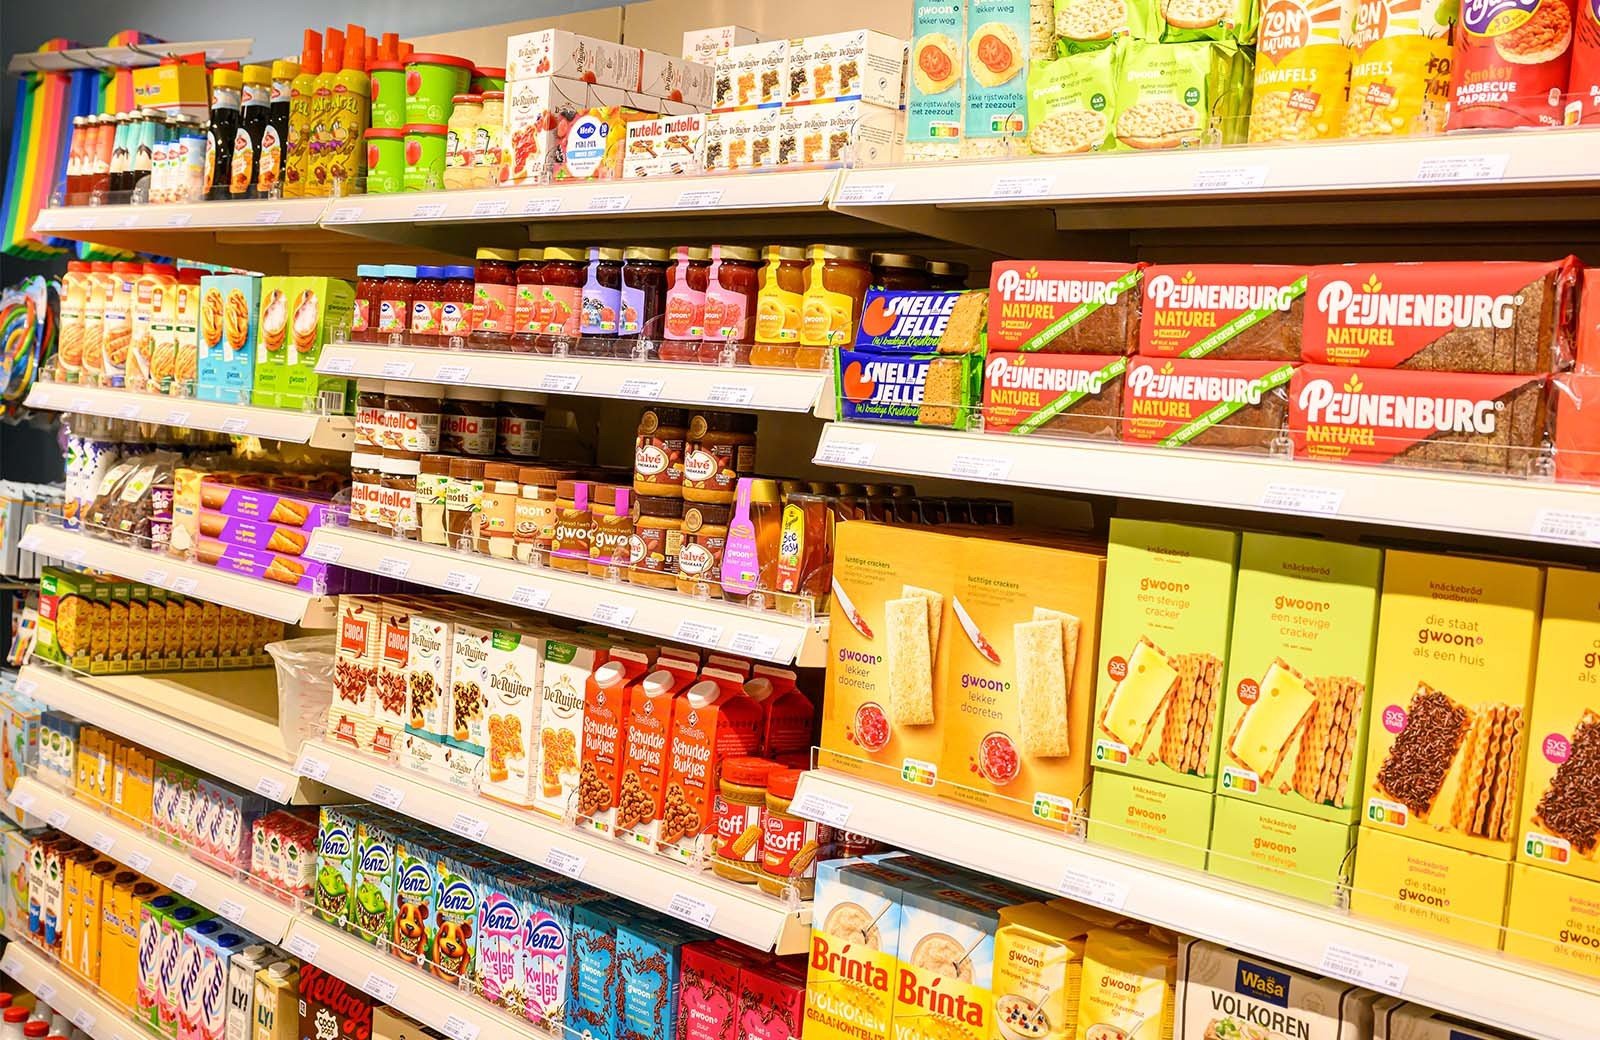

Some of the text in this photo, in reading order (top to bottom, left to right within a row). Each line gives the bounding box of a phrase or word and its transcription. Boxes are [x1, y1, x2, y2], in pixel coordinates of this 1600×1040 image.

[997, 5, 1014, 13] weg
[1265, 10, 1301, 37] ZON
[1263, 35, 1301, 55] NATURA
[1464, 64, 1513, 83] Smokey
[984, 94, 1023, 102] rijstwafels
[1292, 92, 1305, 101] 26
[1371, 86, 1380, 95] 26
[1456, 82, 1517, 97] BARBECUE
[985, 101, 1016, 109] zeezout
[1458, 92, 1509, 106] PAPRIKA
[664, 117, 700, 134] nutella
[883, 296, 960, 317] SNELLE
[1002, 304, 1055, 319] NATUREL
[890, 316, 950, 337] JELLE
[1154, 311, 1217, 328] NATUREL
[1327, 328, 1395, 346] NATUREL
[860, 362, 931, 384] SNELLE
[871, 384, 925, 405] JELLE
[991, 390, 1041, 407] NATUREL
[1132, 399, 1192, 418] NATUREL
[384, 411, 417, 430] utella
[1306, 424, 1375, 446] NATUREL
[636, 453, 662, 465] Calvé
[686, 458, 710, 470] Calvé
[380, 489, 411, 509] utella
[680, 551, 706, 563] Calvé
[1282, 562, 1330, 576] knäckebröd
[1141, 577, 1183, 593] gwoon
[1430, 581, 1483, 597] knäckebröd
[1137, 592, 1191, 610] een stevige
[1275, 596, 1322, 612] gwoon
[1432, 591, 1479, 605] goudbruin
[1145, 606, 1180, 619] cracker
[1271, 612, 1330, 630] een stevige
[1426, 614, 1479, 632] die staat
[1280, 626, 1319, 640] cracker
[1418, 628, 1475, 650] gwoon
[412, 634, 441, 654] De Ruijter
[456, 641, 488, 664] De Ruijter
[839, 648, 876, 665] gwoon
[1413, 647, 1485, 668] als een huis
[845, 665, 870, 678] lekker
[1578, 669, 1598, 683] als
[491, 674, 532, 699] De Ruijter
[838, 674, 876, 691] dooreten
[961, 673, 1004, 693] gwoon
[544, 685, 585, 712] De Ruijter
[968, 691, 997, 706] lekker
[961, 702, 1003, 720] dooreten
[1385, 710, 1404, 722] 5X5
[584, 716, 618, 740] Schudde
[585, 734, 615, 755] Buikjes
[628, 726, 666, 749] Schudde
[1546, 738, 1567, 751] 5X5
[630, 746, 660, 766] Buikjes
[672, 737, 710, 761] Schudde
[673, 759, 705, 778] Buikjes
[1128, 804, 1163, 821] gwoon
[719, 815, 743, 835] coff
[318, 829, 350, 856] Venz
[765, 831, 802, 851] scoff
[1253, 836, 1291, 854] gwoon
[359, 844, 390, 874] Venz
[399, 864, 432, 893] Venz
[1404, 876, 1447, 896] die staat
[438, 882, 475, 911] Venz
[1399, 886, 1444, 907] gwoon
[482, 901, 520, 931] Venz
[1411, 905, 1428, 918] een
[1430, 908, 1451, 925] huis
[1566, 917, 1582, 930] die
[526, 920, 565, 951] Venz
[811, 936, 889, 993] Brinta
[1009, 950, 1039, 968] gwoon
[582, 964, 601, 977] gwoon
[627, 984, 651, 1000] gwoon
[1101, 976, 1136, 993] gwoon
[1241, 969, 1284, 998] Wasa
[232, 987, 248, 1012] LY!
[898, 968, 983, 1028] Brinta
[258, 1005, 274, 1030] LY!
[629, 1004, 649, 1017] strooien
[690, 1009, 715, 1025] gwoon
[808, 989, 886, 1033] VOLKOREN
[1211, 991, 1310, 1040] VOLKOREN
[319, 1016, 336, 1029] COCO
